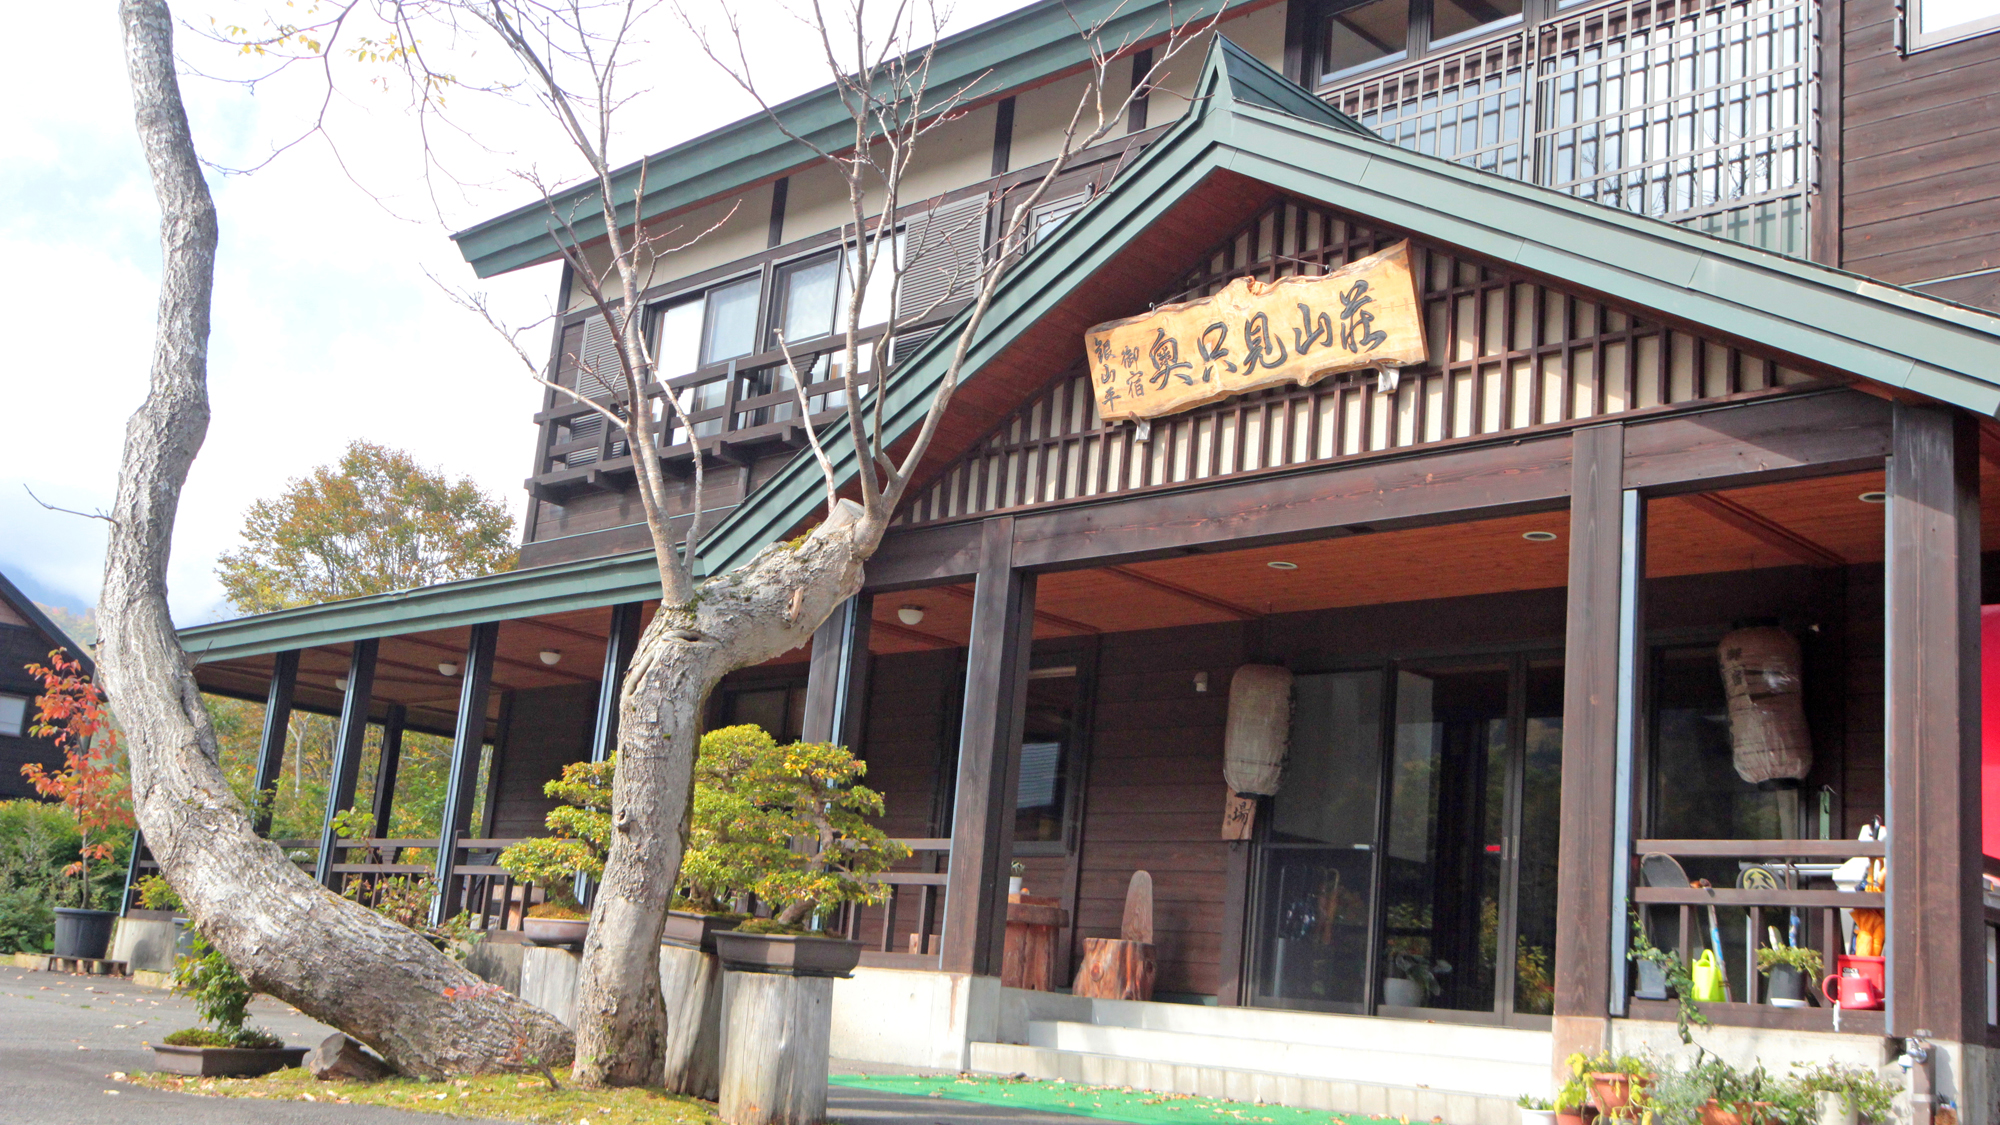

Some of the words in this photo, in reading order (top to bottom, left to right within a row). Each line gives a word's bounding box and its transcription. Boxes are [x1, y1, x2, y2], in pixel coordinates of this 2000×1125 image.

[1094, 337, 1121, 412] 銀山平
[1121, 345, 1145, 399] 御宿
